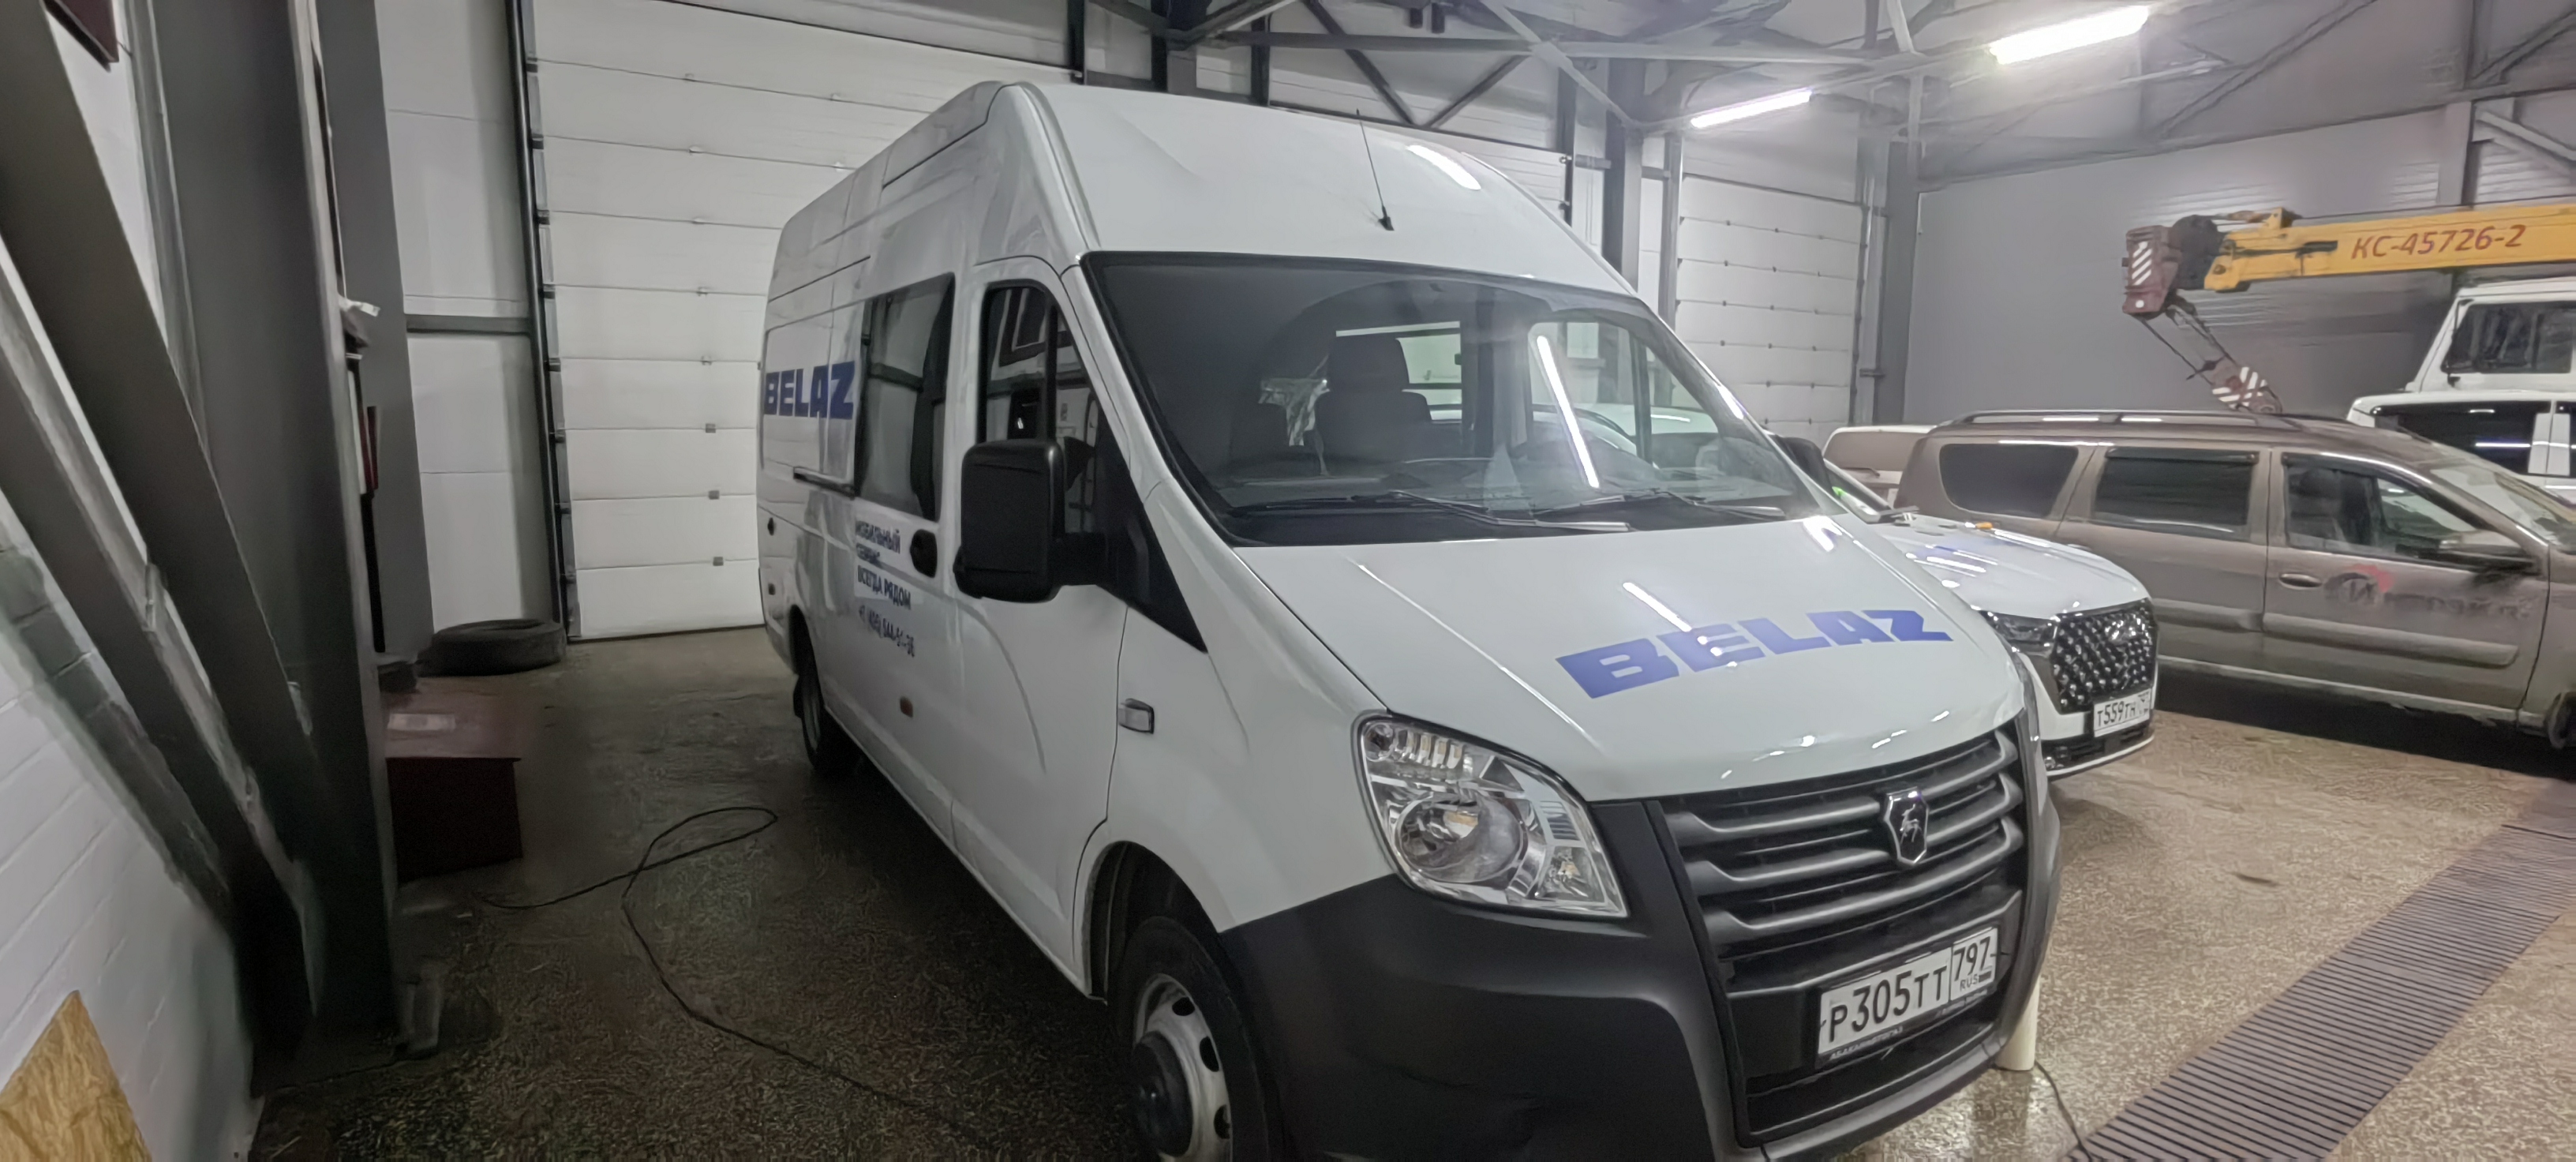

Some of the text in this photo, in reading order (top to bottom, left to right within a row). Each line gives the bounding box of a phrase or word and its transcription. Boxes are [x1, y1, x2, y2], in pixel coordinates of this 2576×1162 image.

[2351, 223, 2526, 260] КС-45726-2
[763, 361, 856, 420] BELAZ
[1556, 610, 1954, 699] BELAZ
[1829, 965, 1948, 1043] Р305ТТ
[1953, 936, 1991, 982] 797
[1960, 974, 1979, 992] RUS
